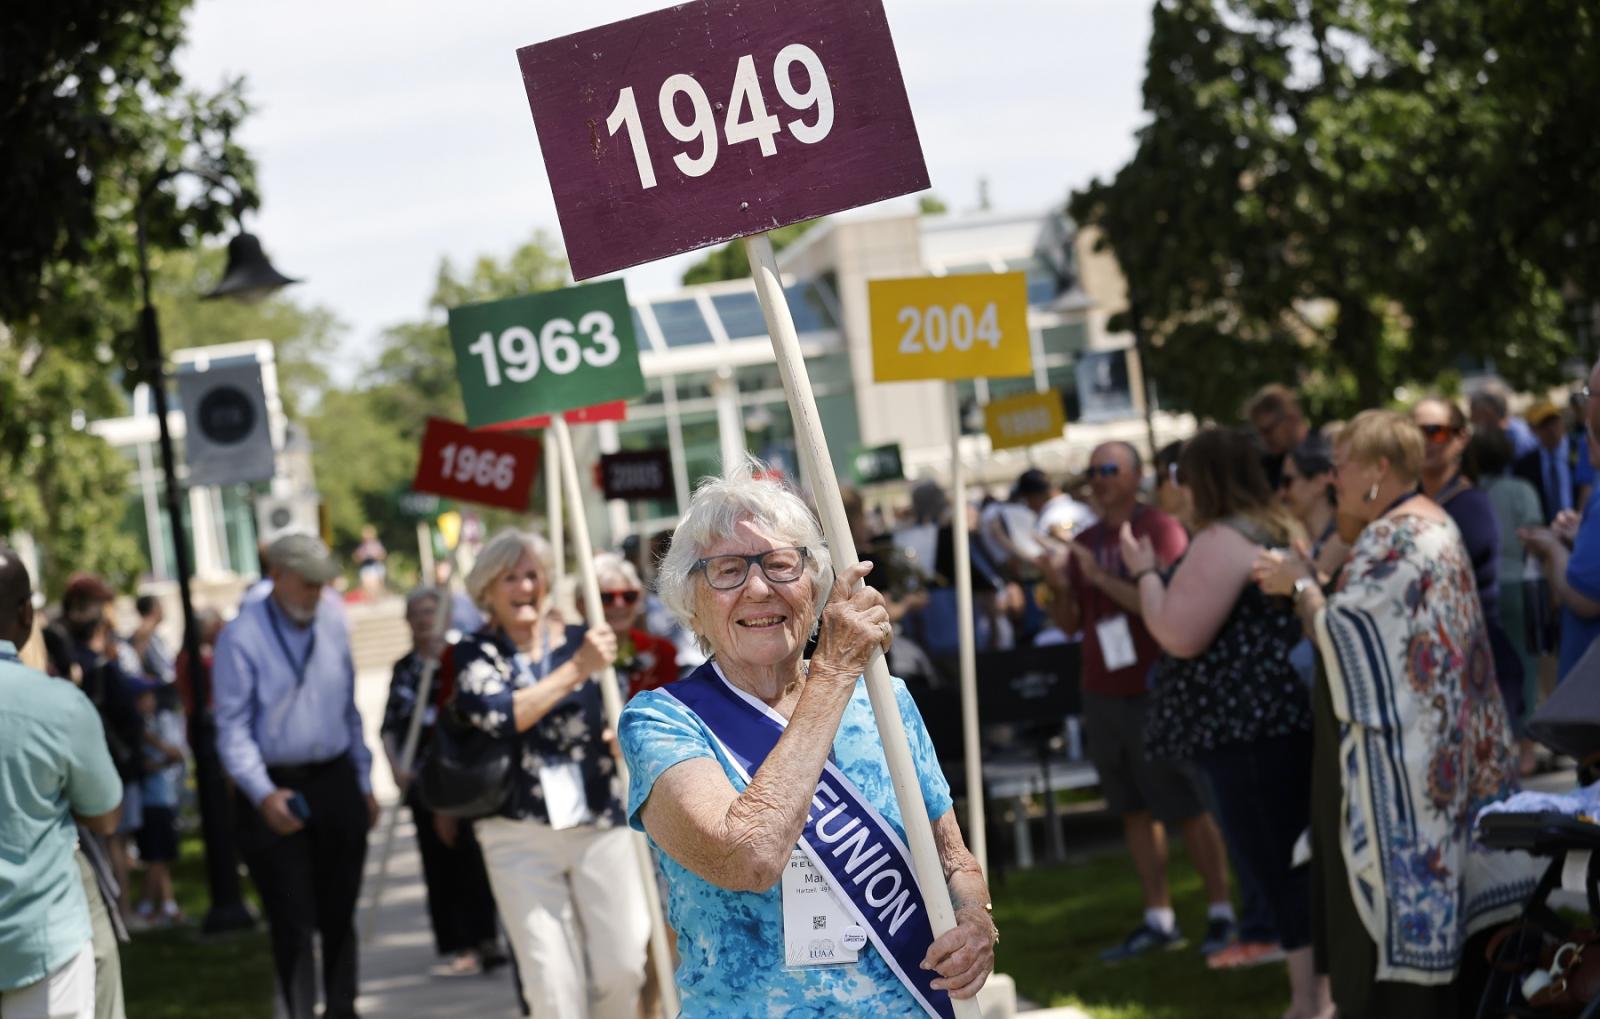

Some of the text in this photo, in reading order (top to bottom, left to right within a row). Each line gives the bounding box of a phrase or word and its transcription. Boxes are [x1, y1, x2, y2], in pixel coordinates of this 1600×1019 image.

[606, 42, 834, 189] 1949
[469, 310, 621, 387] 1963
[897, 302, 1003, 354] 2004
[440, 443, 517, 491] 1966
[804, 873, 826, 884] Mar
[807, 780, 918, 937] EUNION
